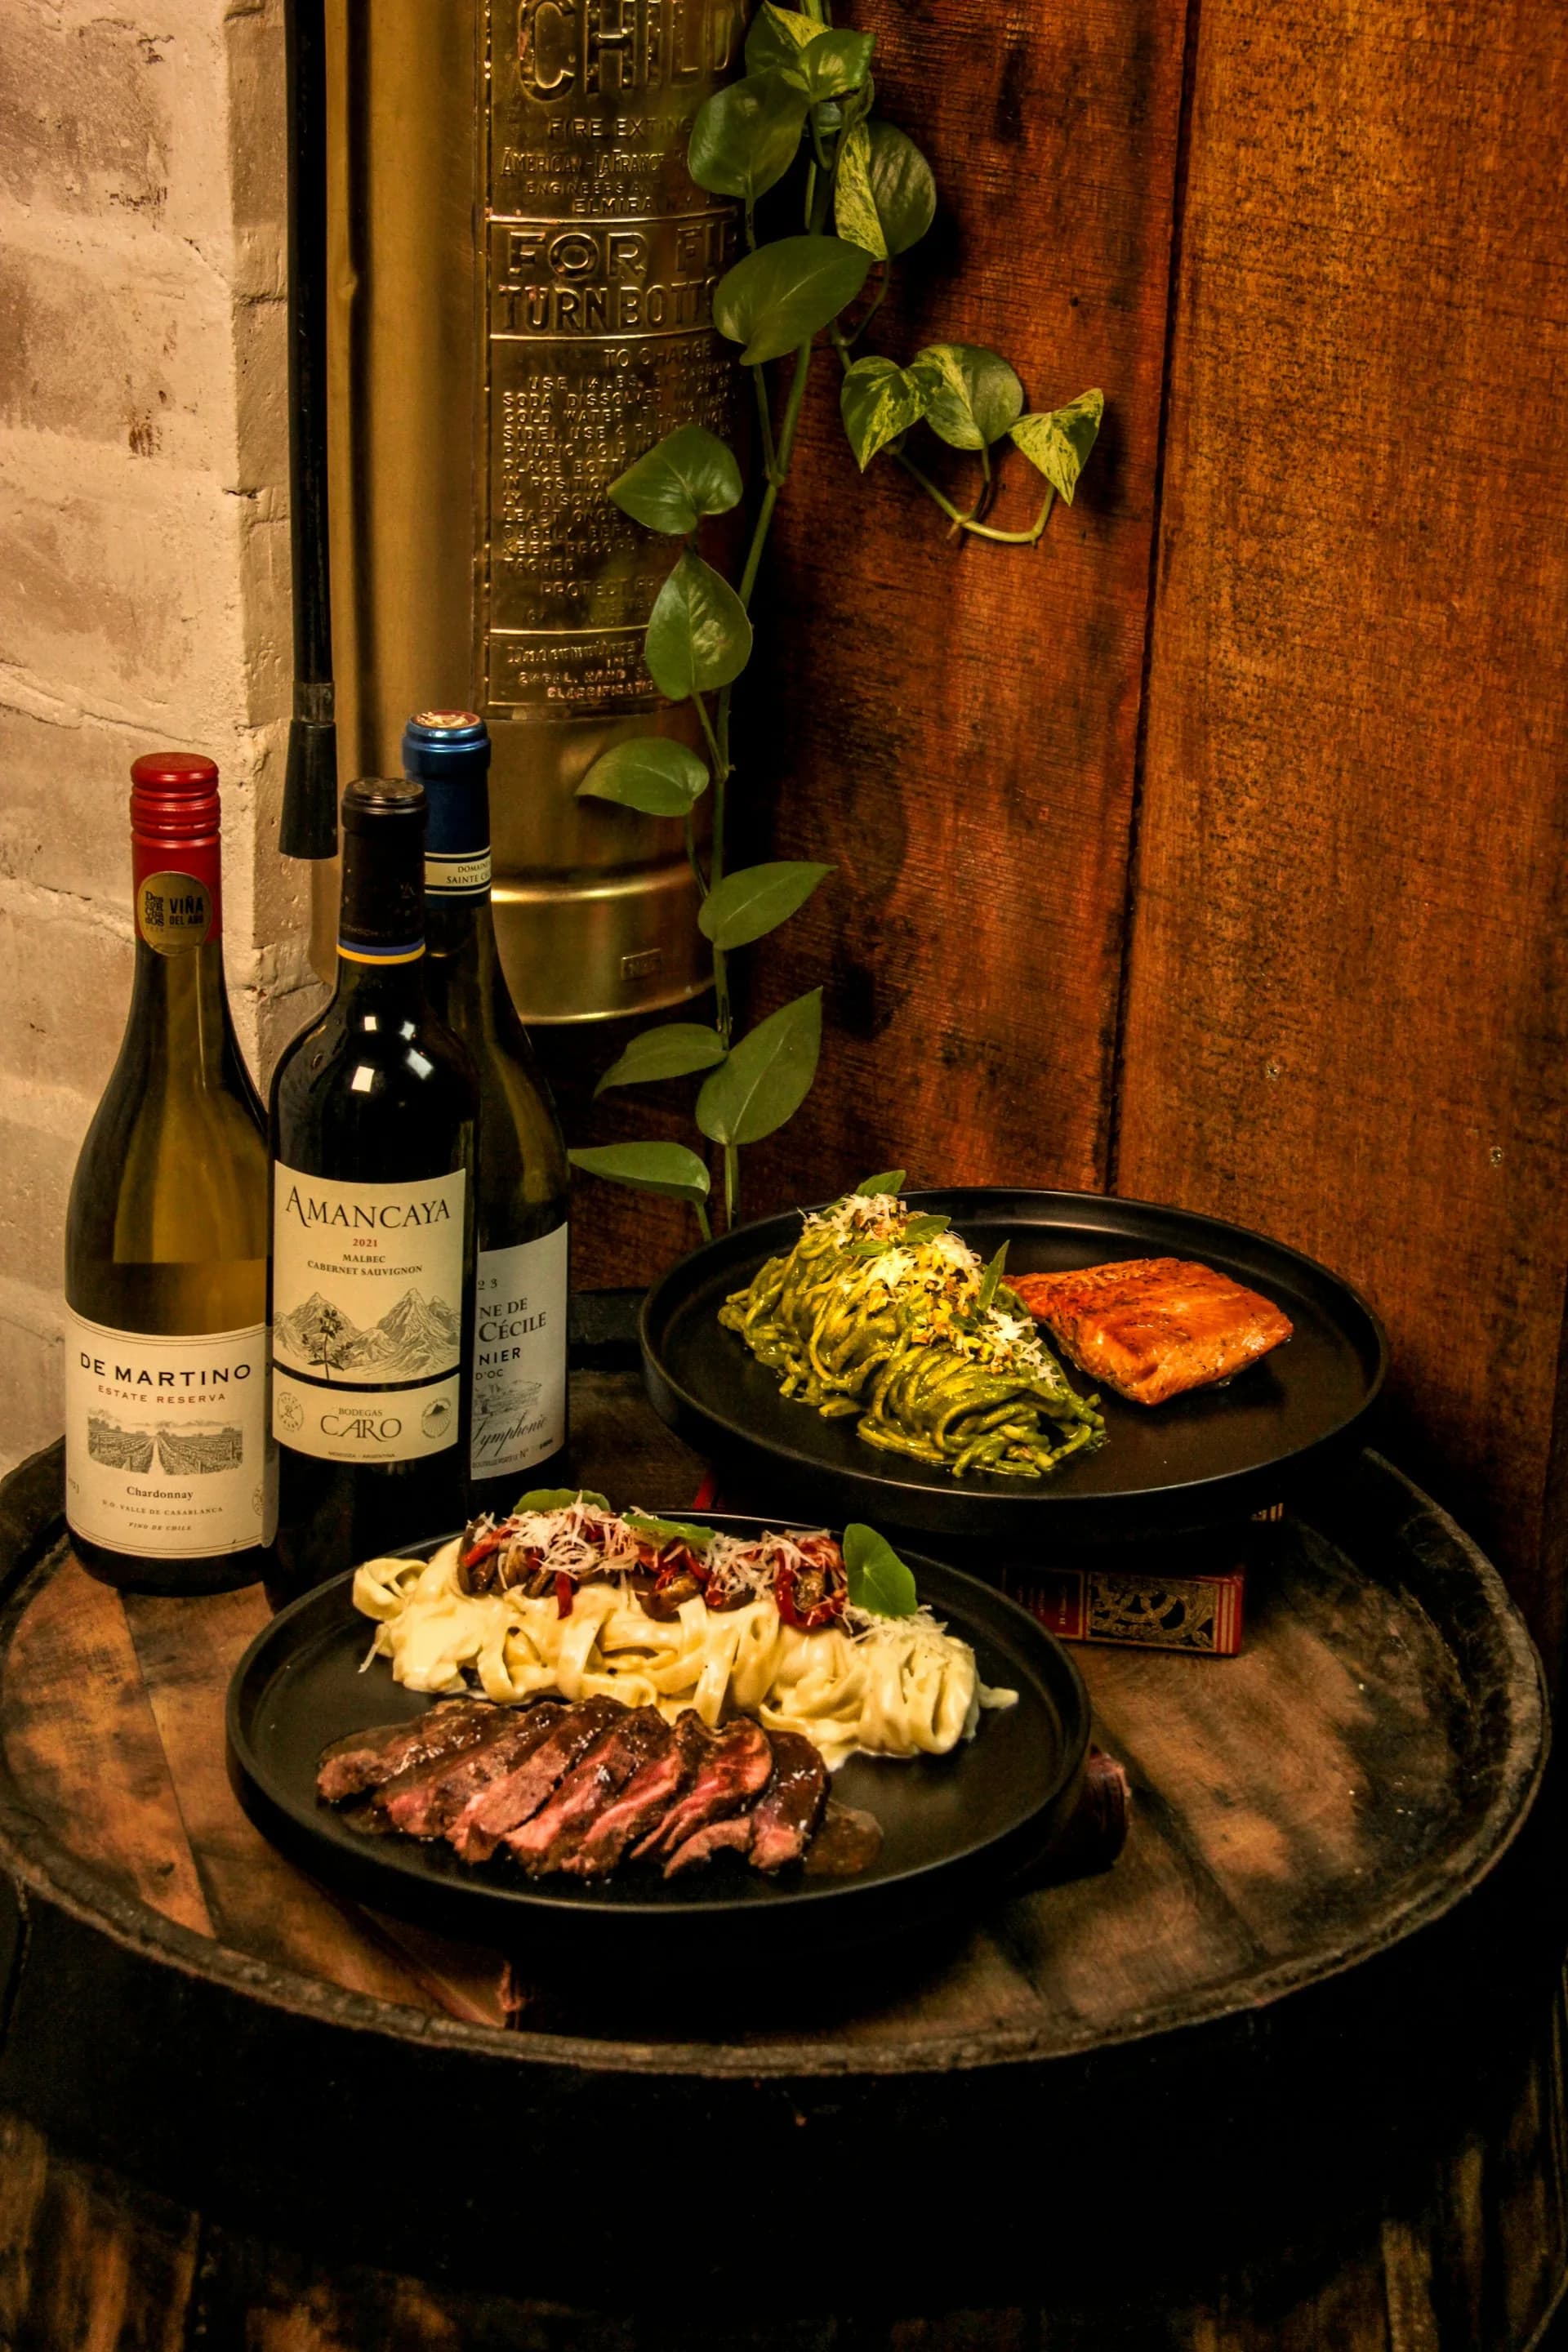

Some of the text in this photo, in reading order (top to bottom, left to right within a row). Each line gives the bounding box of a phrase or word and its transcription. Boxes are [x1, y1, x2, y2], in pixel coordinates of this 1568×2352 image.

[547, 118, 603, 138] FIRE
[525, 180, 625, 195] ENGINEERS
[508, 231, 648, 280] FOR
[498, 285, 608, 332] TURN
[604, 336, 713, 368] TO CHARGE
[529, 376, 569, 392] USE
[502, 392, 553, 407] SODA
[568, 389, 664, 408] DISSOLVED
[503, 408, 552, 423] COLD
[563, 408, 624, 423] WATER
[570, 425, 605, 440] USE
[502, 442, 574, 457] PHURIC
[586, 441, 628, 457] ACID
[502, 458, 562, 474] PLACE
[501, 475, 520, 491] IN
[502, 507, 619, 523] LEAST ONCE
[502, 540, 553, 555] KEEP
[541, 577, 629, 599] PROTECT
[446, 875, 479, 884] SAINTE
[169, 895, 204, 914] VIÑA
[285, 1185, 451, 1228] AMANCAYA
[352, 1238, 378, 1248] 2021
[342, 1254, 386, 1263] MALBEC
[307, 1260, 423, 1276] CABERNET SAUVIGNON
[507, 1297, 528, 1315] DE
[478, 1312, 547, 1343] CÉCILE
[479, 1347, 521, 1366] NIER
[80, 1352, 252, 1387] DE MARTINO
[98, 1384, 226, 1404] ESTATE RESERVA
[338, 1407, 383, 1418] BODEGAS
[320, 1414, 403, 1443] CARO
[127, 1486, 194, 1500] Chardonnay
[120, 1504, 146, 1515] VALLE
[164, 1506, 223, 1516] CASABLANCA
